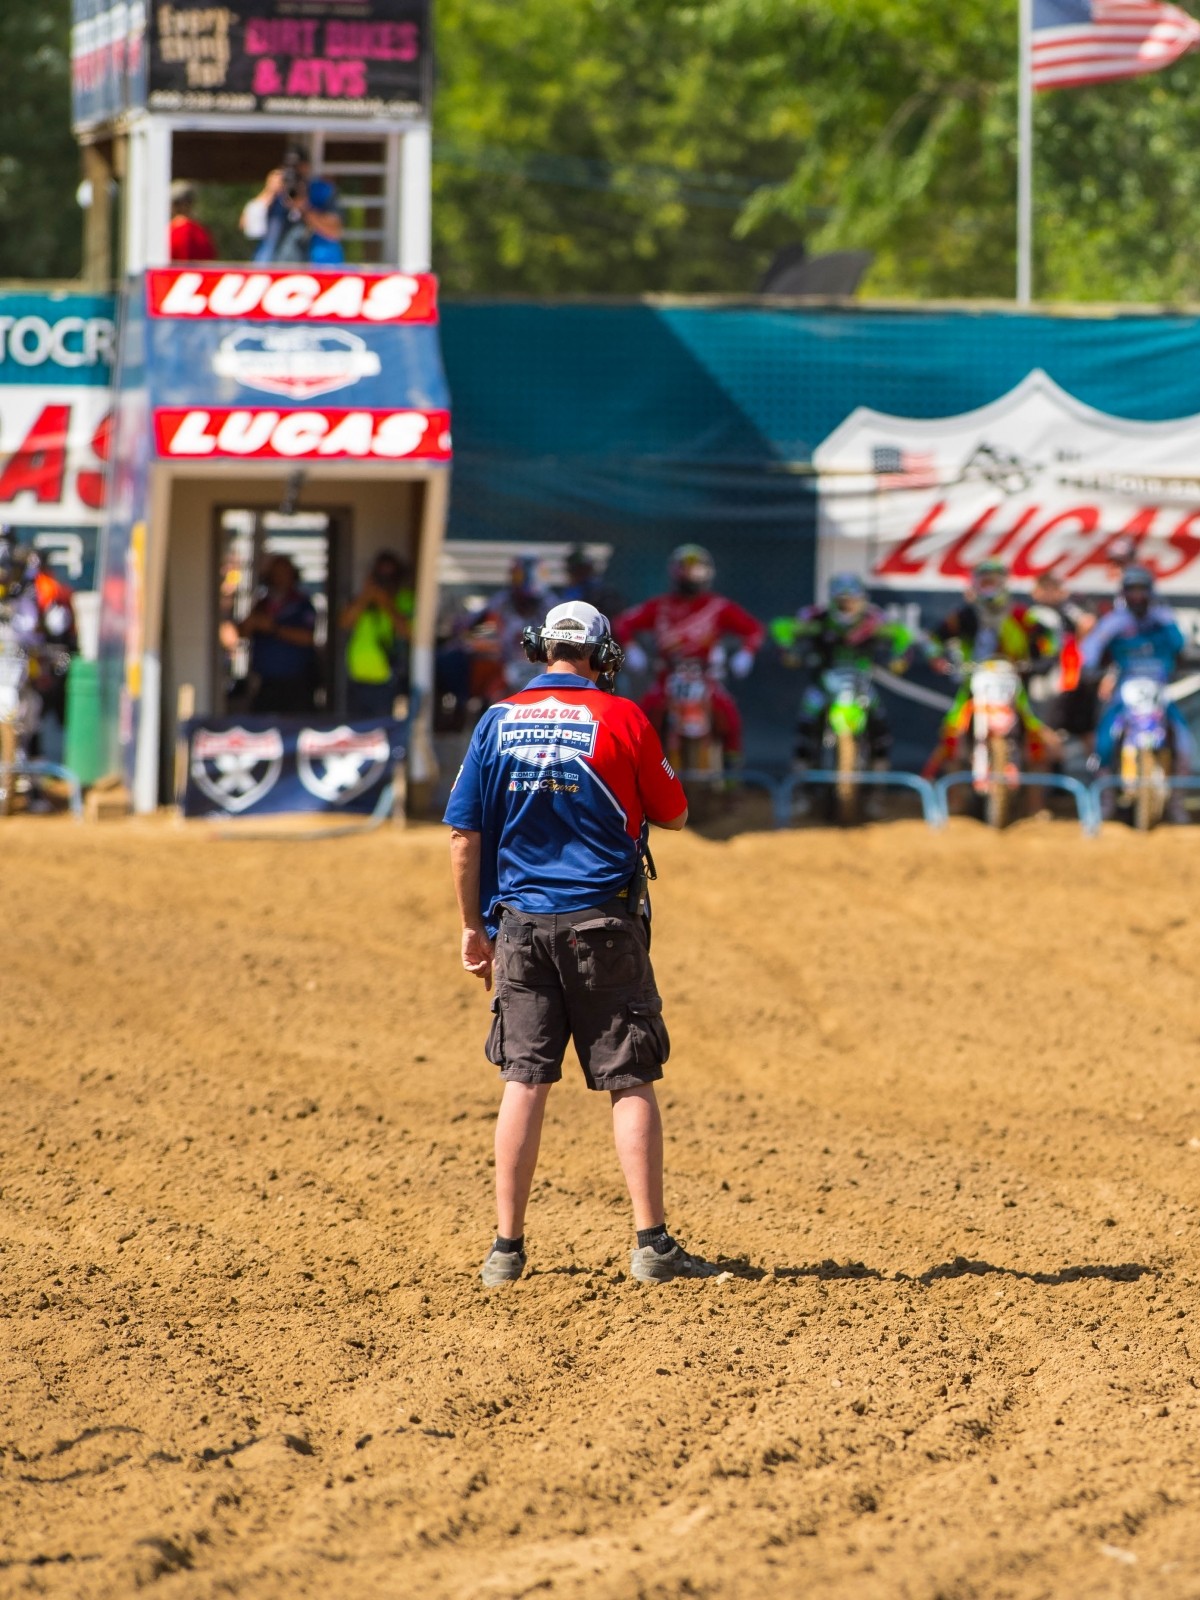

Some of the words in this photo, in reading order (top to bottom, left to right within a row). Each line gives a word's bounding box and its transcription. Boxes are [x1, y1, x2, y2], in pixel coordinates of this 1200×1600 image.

[160, 272, 419, 321] LUCAS
[169, 411, 429, 457] LUCAS
[514, 708, 558, 720] LUCAS
[559, 708, 582, 720] OIL
[502, 728, 592, 743] MOTOCROSS
[523, 779, 550, 791] NBC
